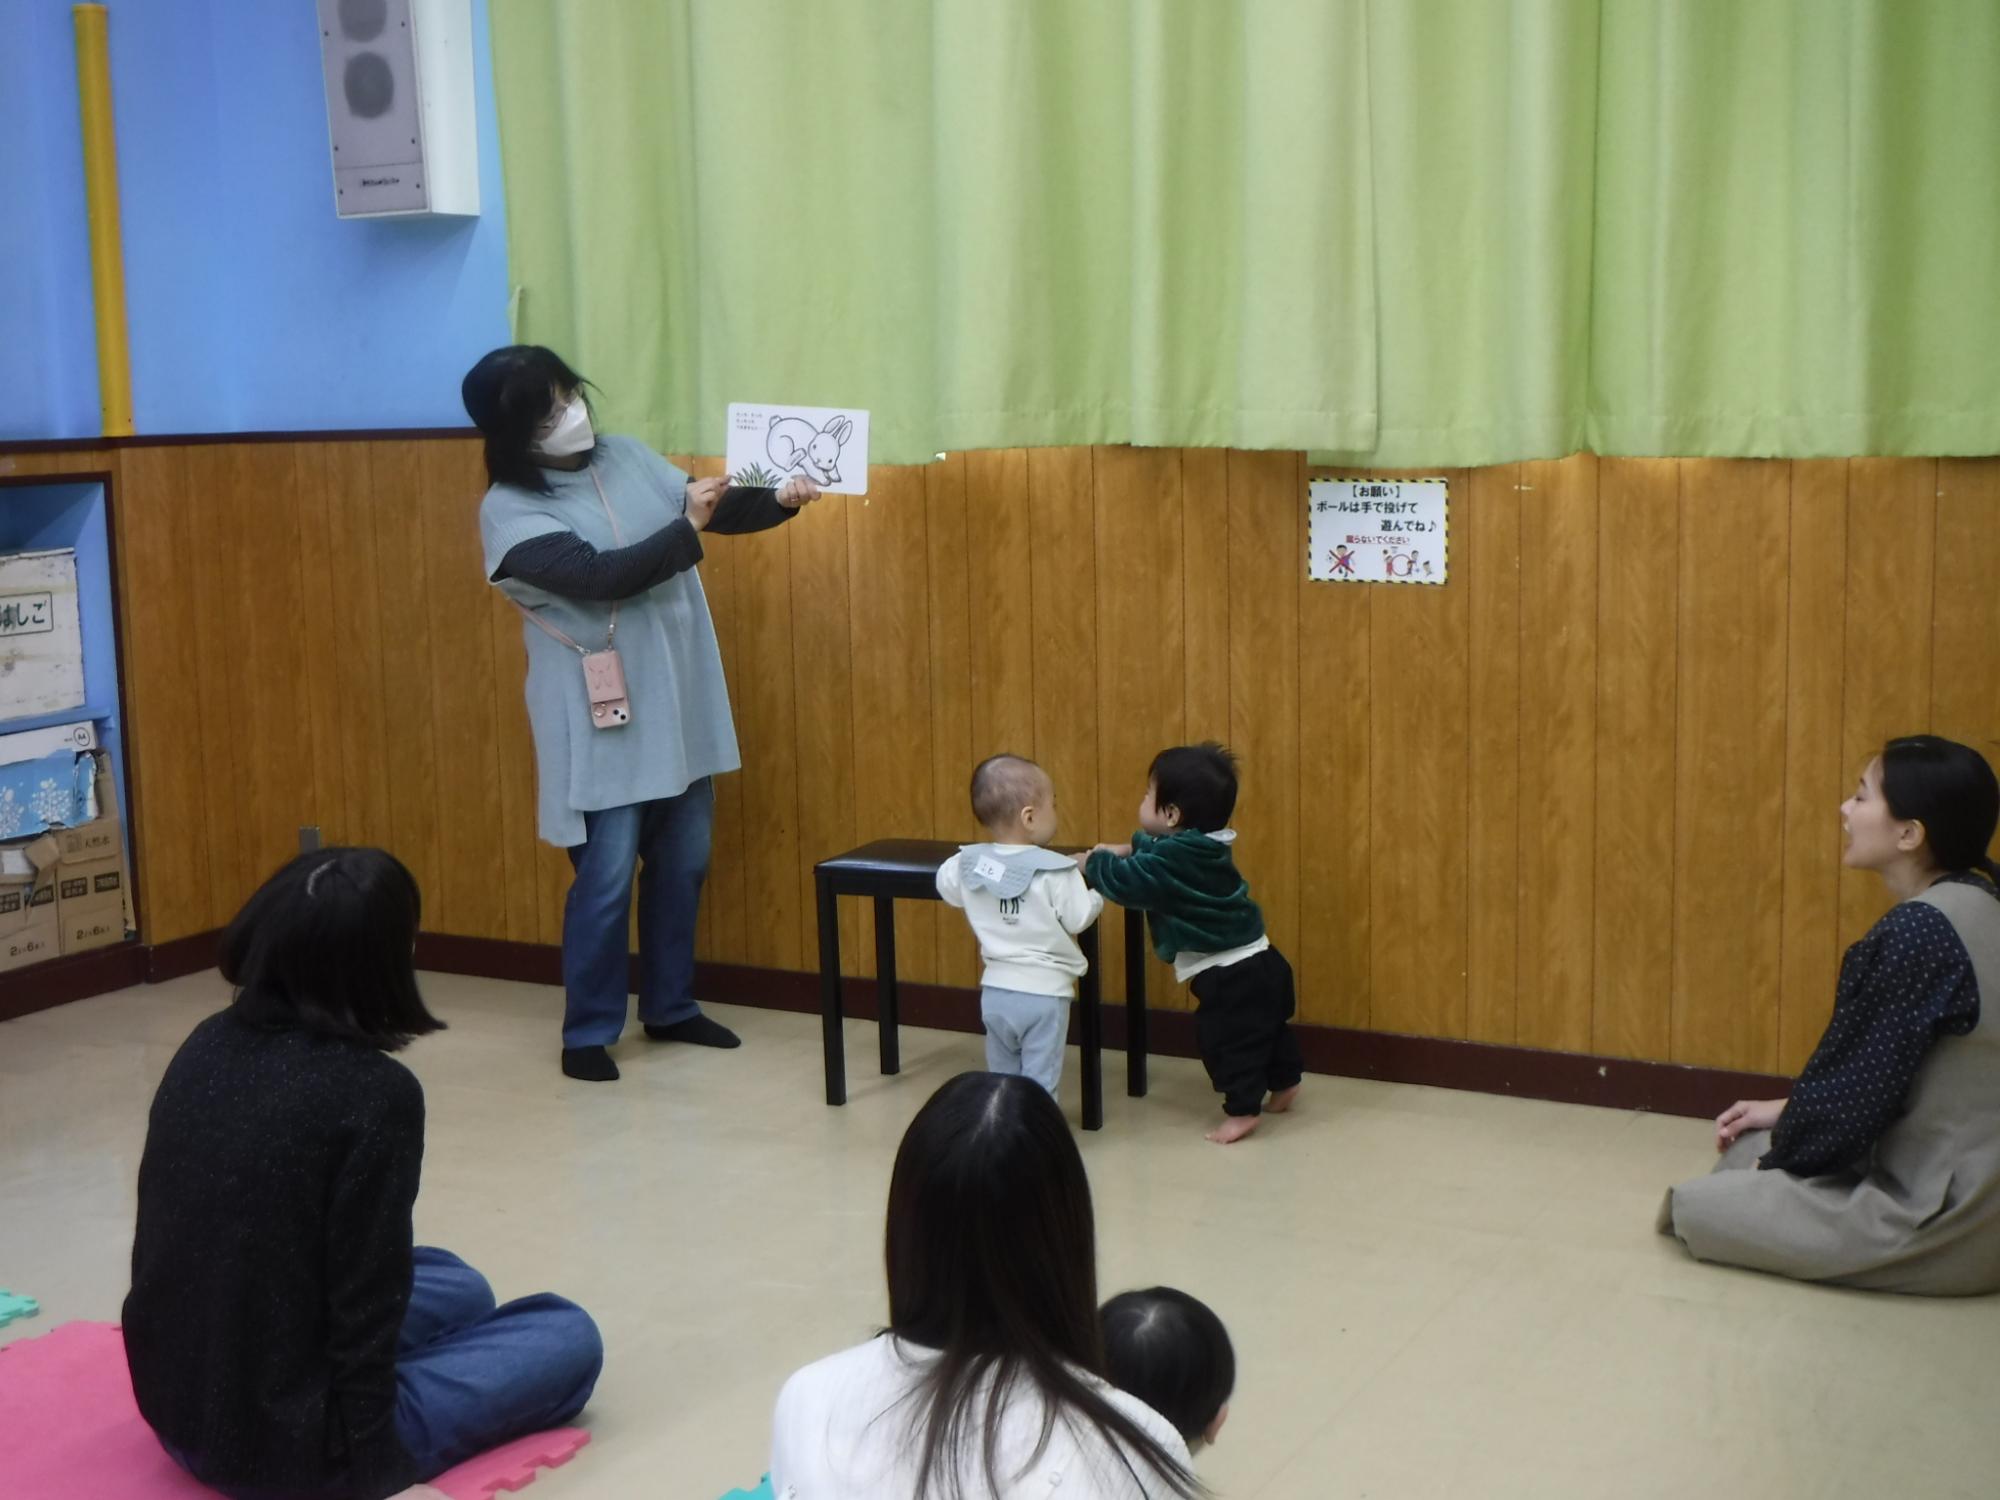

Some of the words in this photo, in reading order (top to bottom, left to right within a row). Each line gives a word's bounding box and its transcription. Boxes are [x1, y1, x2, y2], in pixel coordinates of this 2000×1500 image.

[1316, 501, 1419, 514] ボールは手で投げて
